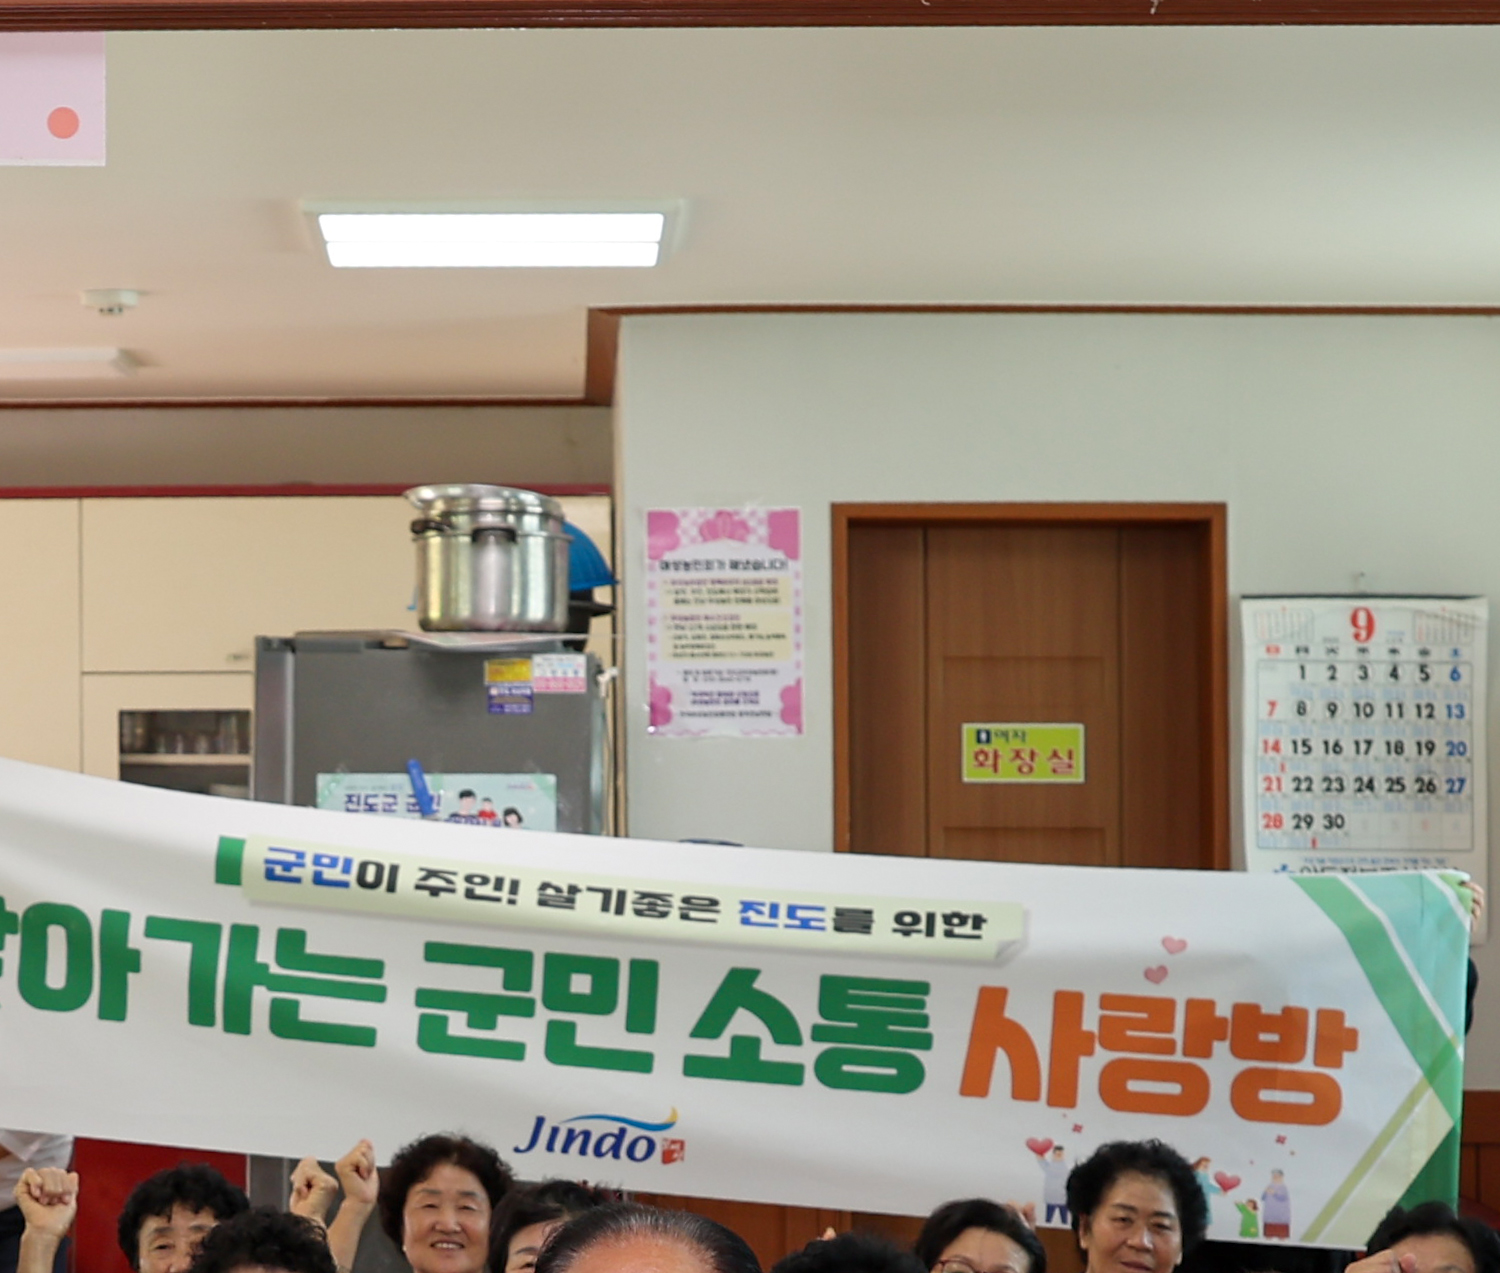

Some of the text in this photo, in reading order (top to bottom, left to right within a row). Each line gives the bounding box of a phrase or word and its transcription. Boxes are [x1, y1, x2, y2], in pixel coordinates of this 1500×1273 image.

[1350, 606, 1375, 643] 9
[1299, 665, 1461, 682] 1 2 3 4 5 6
[1267, 700, 1465, 719] 7 8 9 10 11 12 13
[1262, 740, 1467, 756] 14 15 16 17 18 19 20
[973, 748, 1075, 775] 화장실
[1263, 776, 1466, 794] 21 22 23 24 25 26 27
[344, 794, 399, 812] 진도군
[1262, 814, 1344, 830] 28 29 30
[263, 845, 988, 940] 군민이 주인! 살기좋은 진도를 위한
[415, 941, 660, 1074] 군민
[682, 966, 934, 1095] 소통
[958, 984, 1360, 1127] 사랑방
[513, 1115, 657, 1163] Jindo
